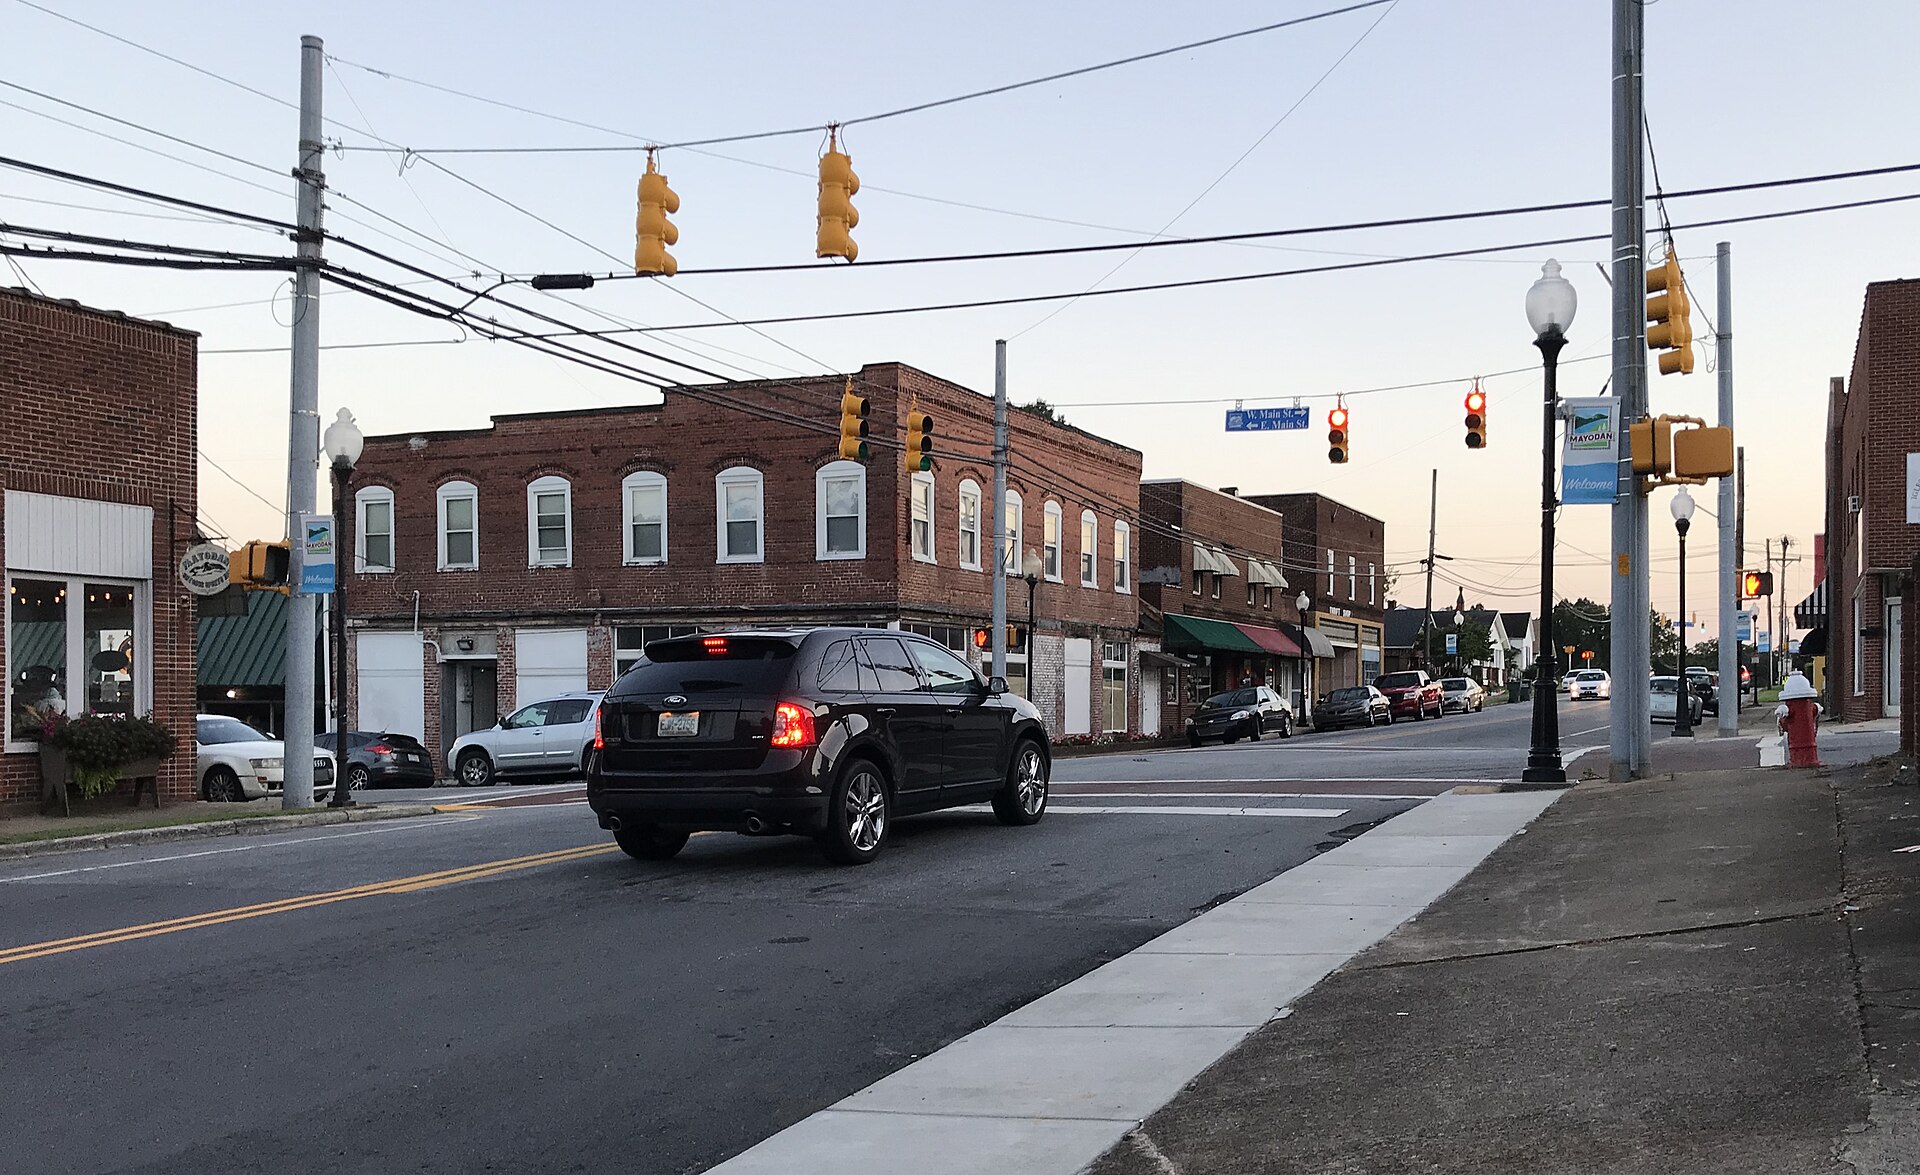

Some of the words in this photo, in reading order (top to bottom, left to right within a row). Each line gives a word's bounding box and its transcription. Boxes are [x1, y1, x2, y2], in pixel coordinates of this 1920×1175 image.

[1247, 410, 1257, 420] W.
[1260, 408, 1280, 419] Main
[1283, 408, 1293, 418] St.
[1261, 421, 1270, 430] E.
[1273, 419, 1293, 430] Main
[1296, 418, 1307, 428] St.
[1569, 433, 1612, 443] MAYODAN
[1565, 478, 1613, 490] Welcome
[305, 575, 332, 584] Welcome
